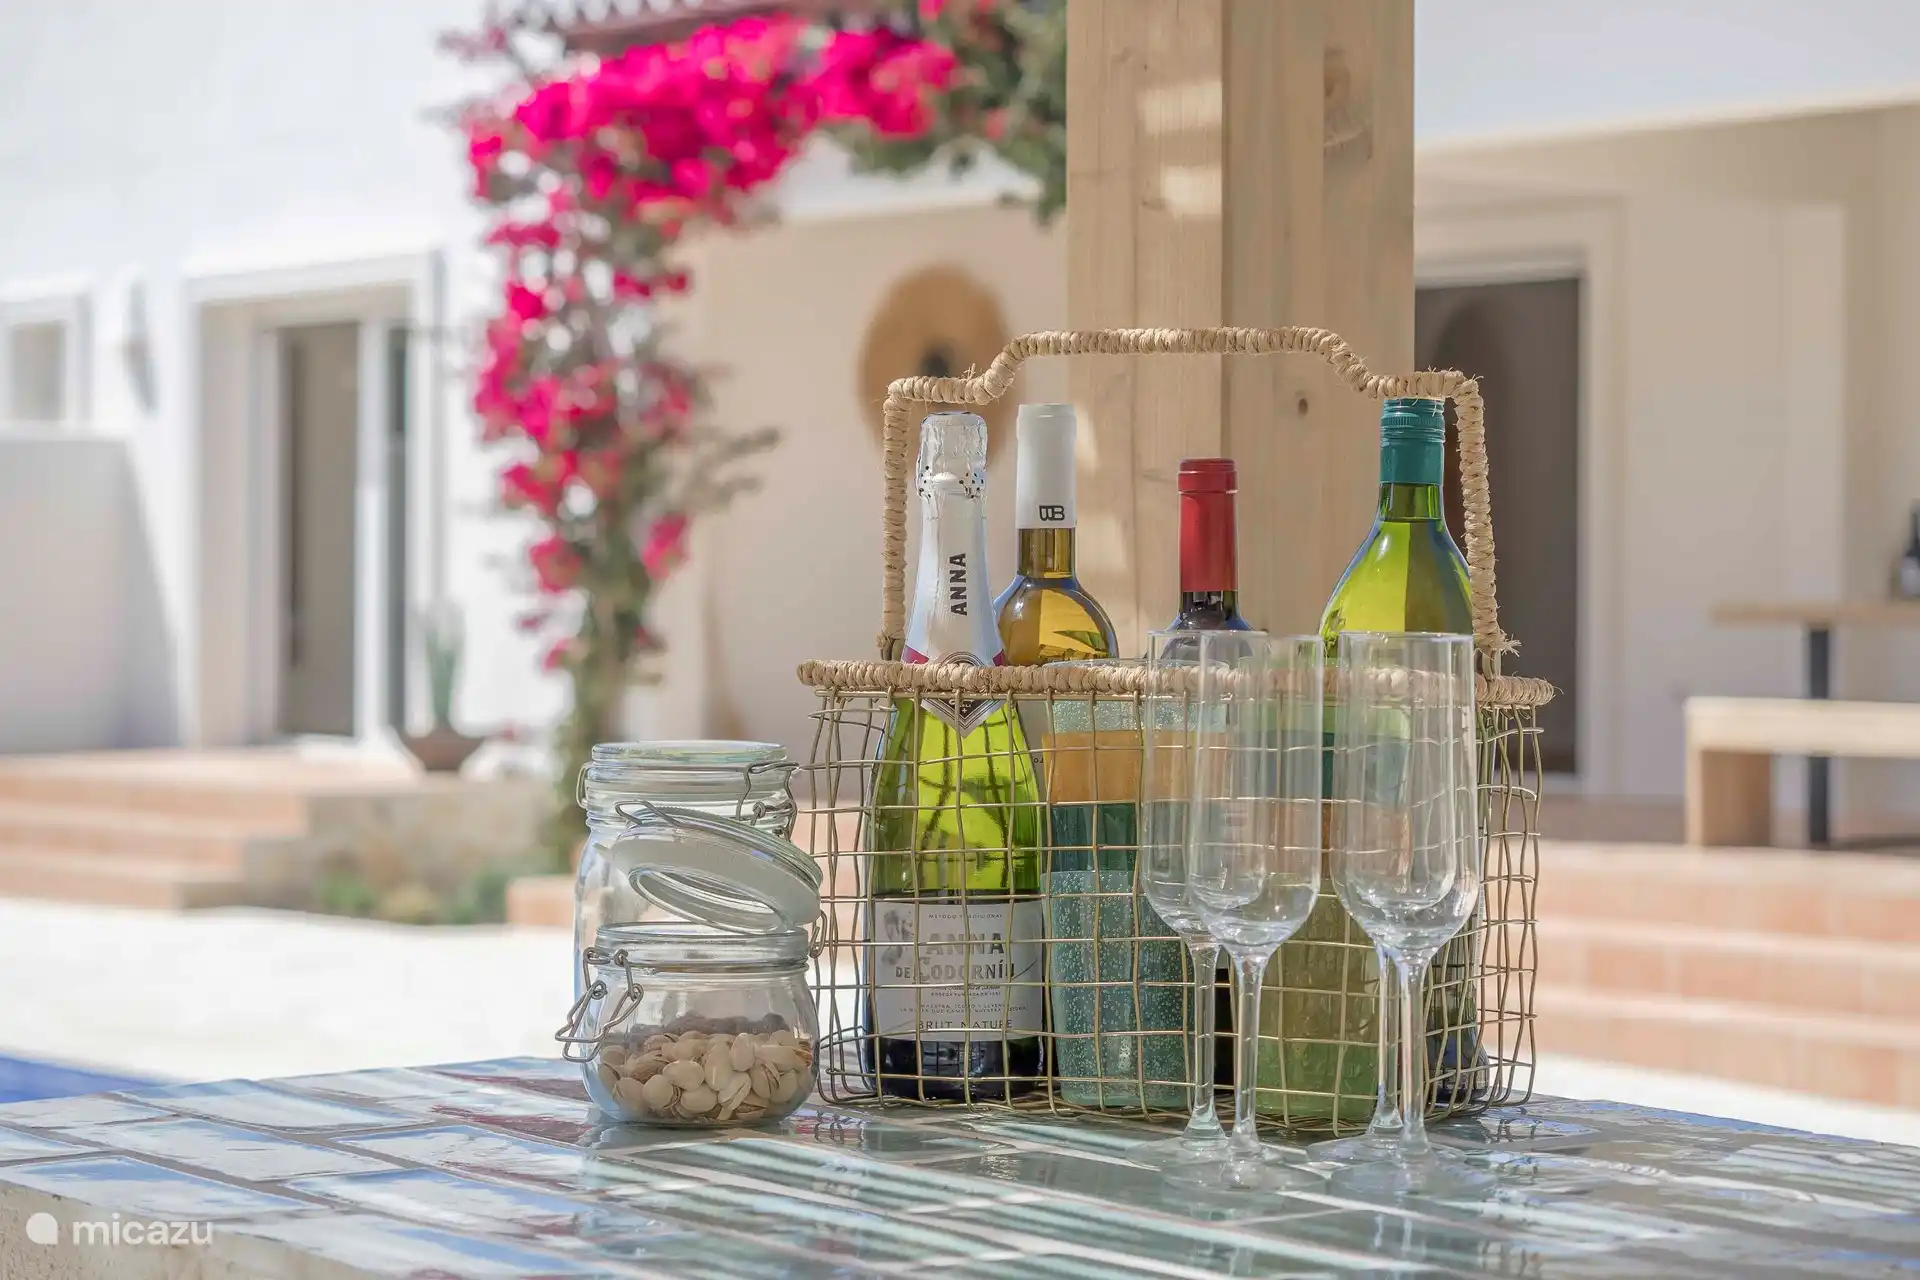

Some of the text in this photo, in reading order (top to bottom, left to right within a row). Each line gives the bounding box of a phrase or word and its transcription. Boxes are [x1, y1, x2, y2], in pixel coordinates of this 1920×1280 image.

[949, 553, 967, 616] ANNA
[926, 932, 1004, 955] ANNA
[895, 966, 911, 978] DE
